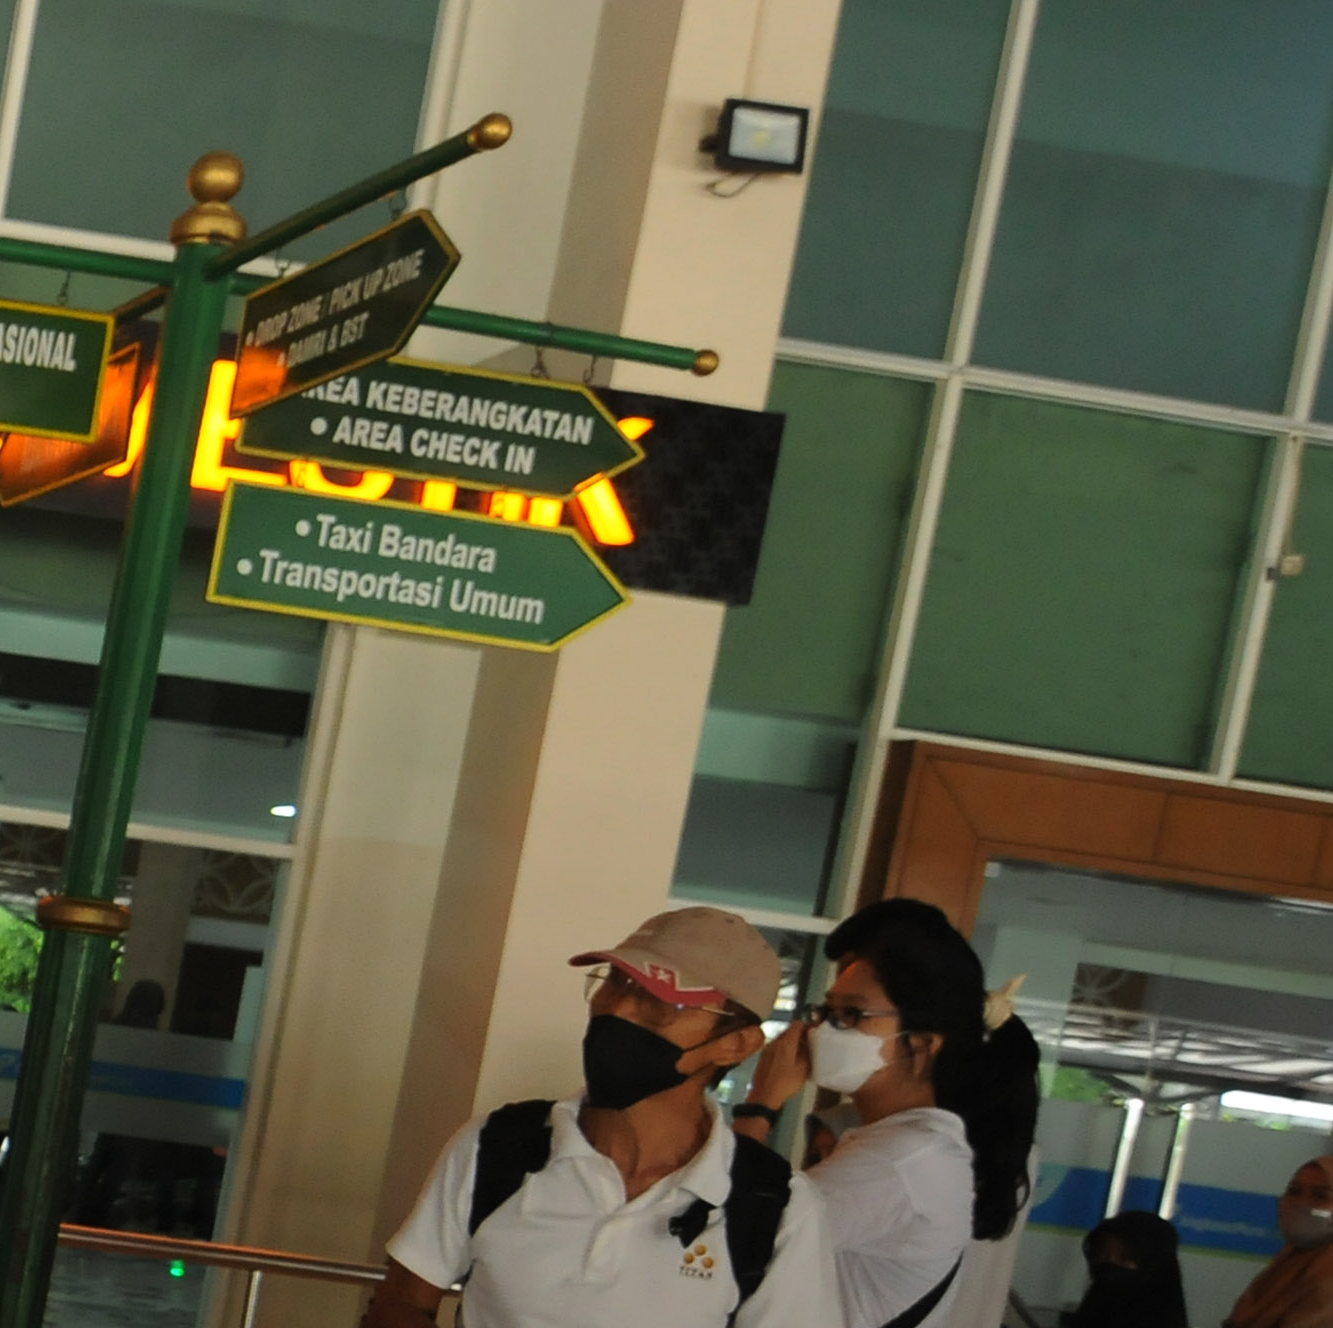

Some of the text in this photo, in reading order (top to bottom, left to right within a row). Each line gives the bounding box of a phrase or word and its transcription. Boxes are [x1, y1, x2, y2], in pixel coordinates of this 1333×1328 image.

[363, 267, 385, 300] UP
[383, 248, 426, 292] ZONE
[301, 376, 595, 446] REA KEBERANGKATAN
[332, 416, 535, 475] AREA CHECK IN
[317, 513, 497, 574] Taxi Bandara
[259, 549, 545, 625] Transportasi Umum
